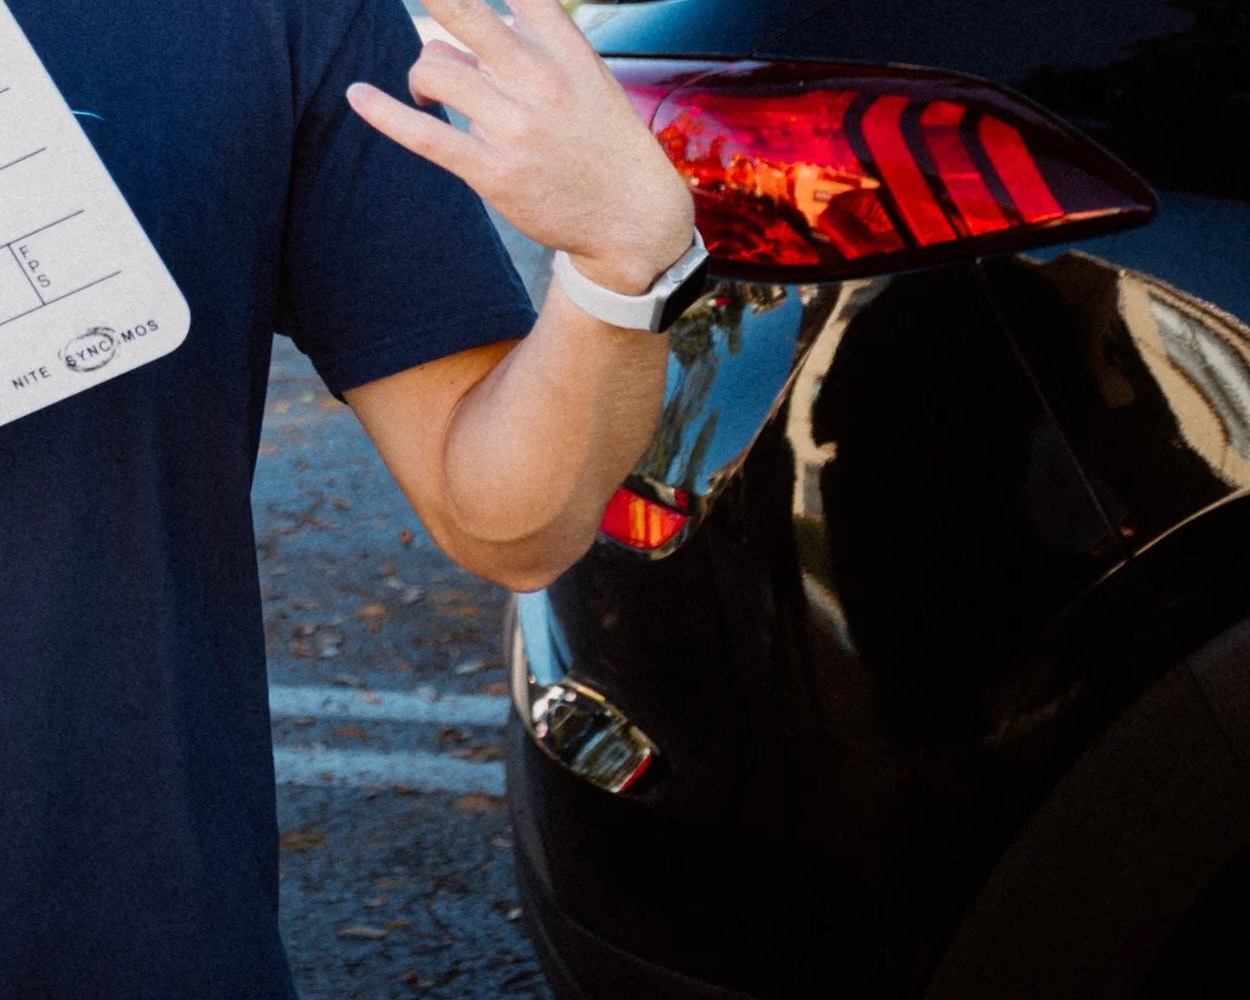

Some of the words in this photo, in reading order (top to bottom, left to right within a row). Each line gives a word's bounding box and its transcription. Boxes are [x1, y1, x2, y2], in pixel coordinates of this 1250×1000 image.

[18, 244, 51, 289] FPS
[11, 366, 52, 391] NITE
[64, 339, 112, 368] SYNC
[120, 319, 160, 344] MOS
